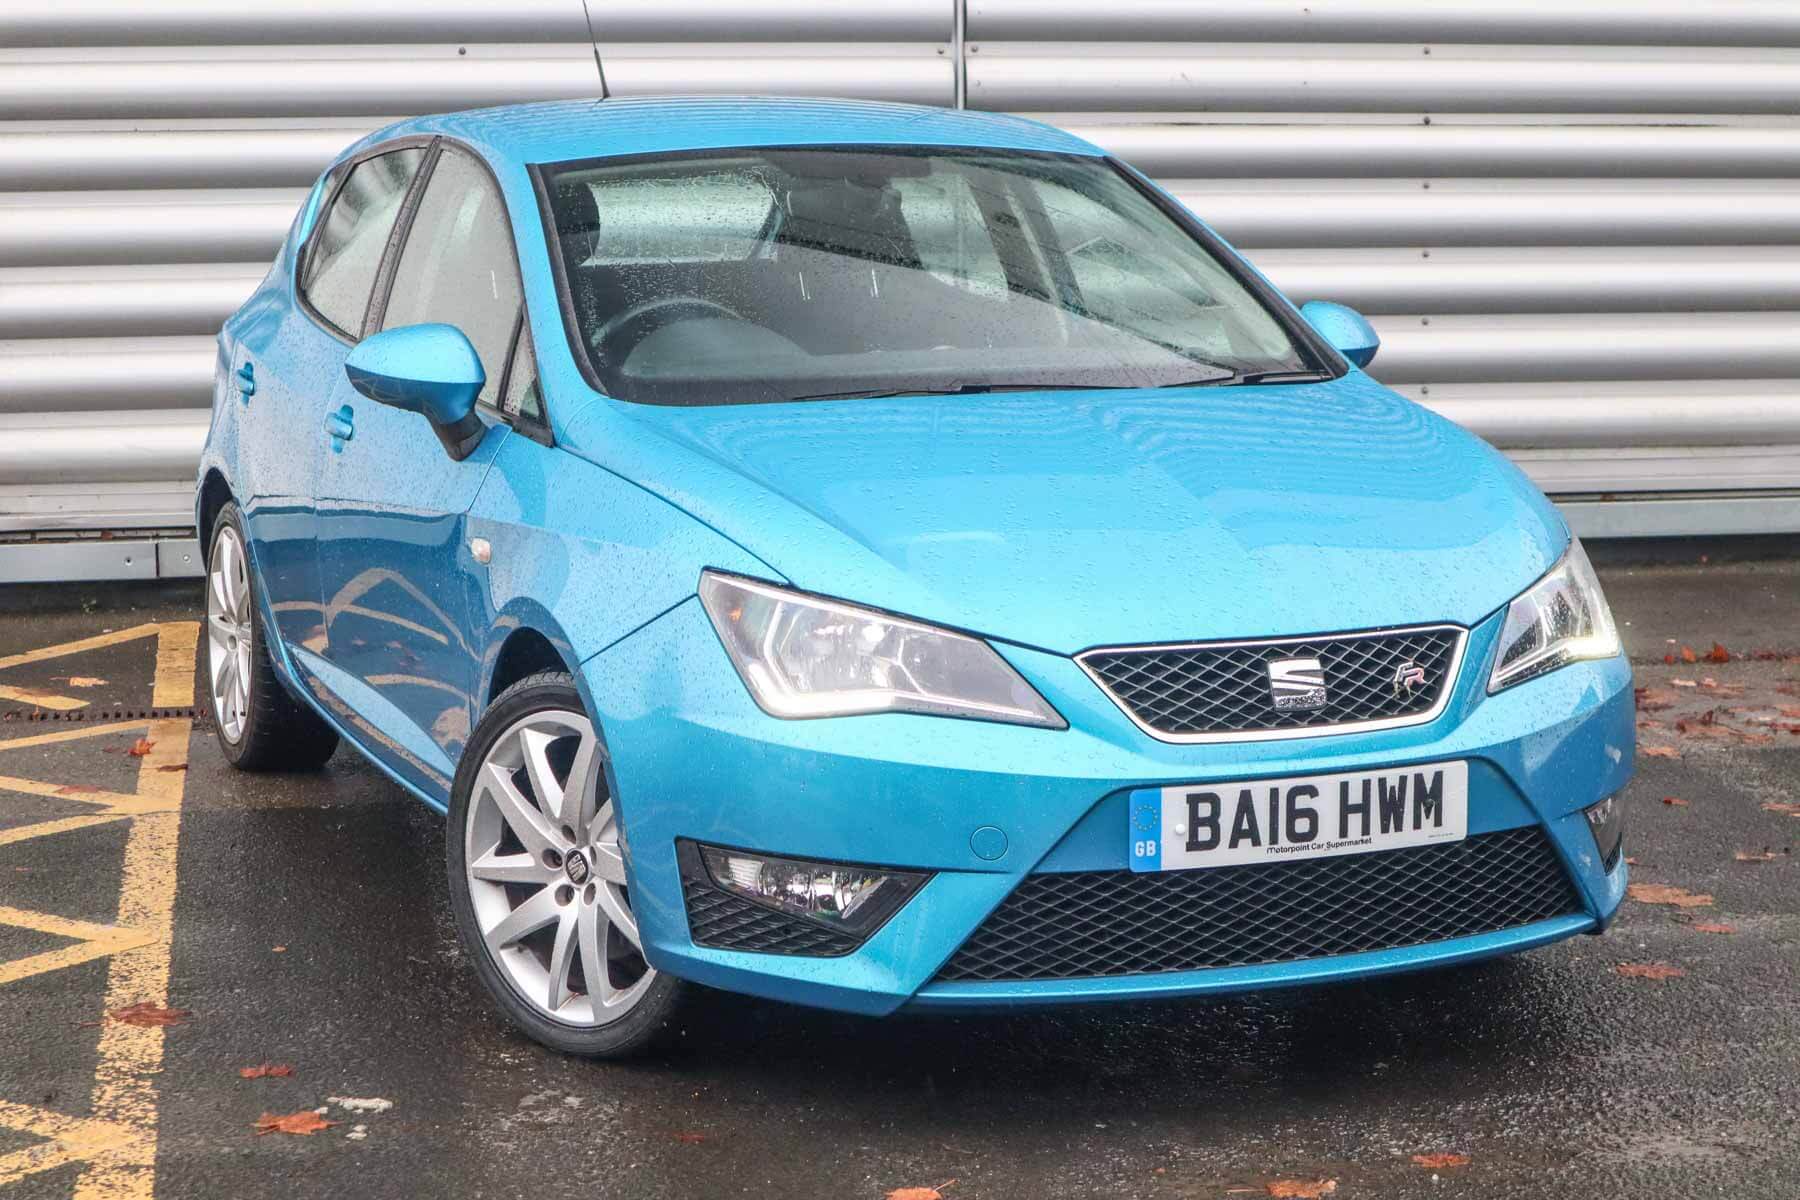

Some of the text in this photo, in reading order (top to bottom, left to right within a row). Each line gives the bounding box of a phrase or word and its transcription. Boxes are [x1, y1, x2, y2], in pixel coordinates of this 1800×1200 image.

[1185, 770, 1444, 853] BA16 HWM
[1135, 840, 1156, 857] GB
[1311, 842, 1325, 850] Car
[1326, 837, 1372, 849] Supermarket
